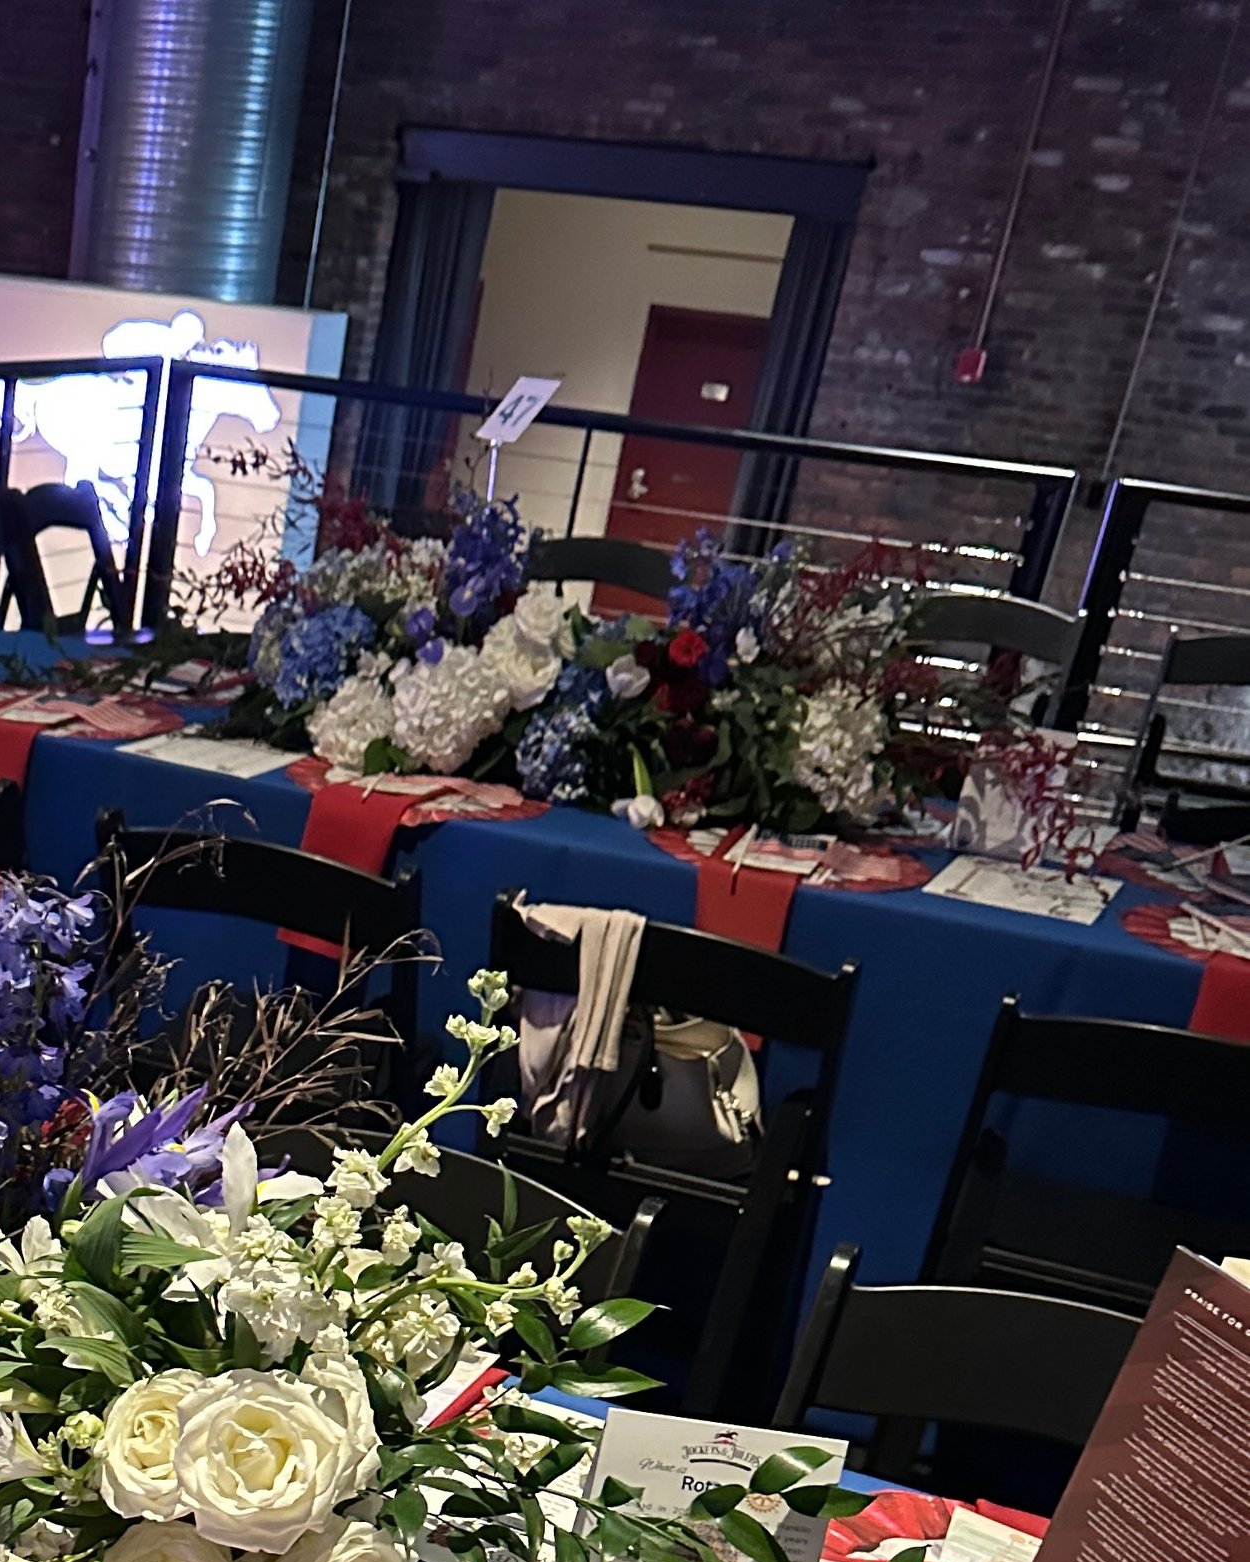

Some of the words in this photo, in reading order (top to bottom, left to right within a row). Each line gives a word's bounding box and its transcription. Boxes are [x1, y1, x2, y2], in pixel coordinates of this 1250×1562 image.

[499, 394, 539, 427] 47
[1185, 1289, 1220, 1315] PRAISE
[1222, 1313, 1243, 1330] FOR
[637, 1456, 677, 1474] What
